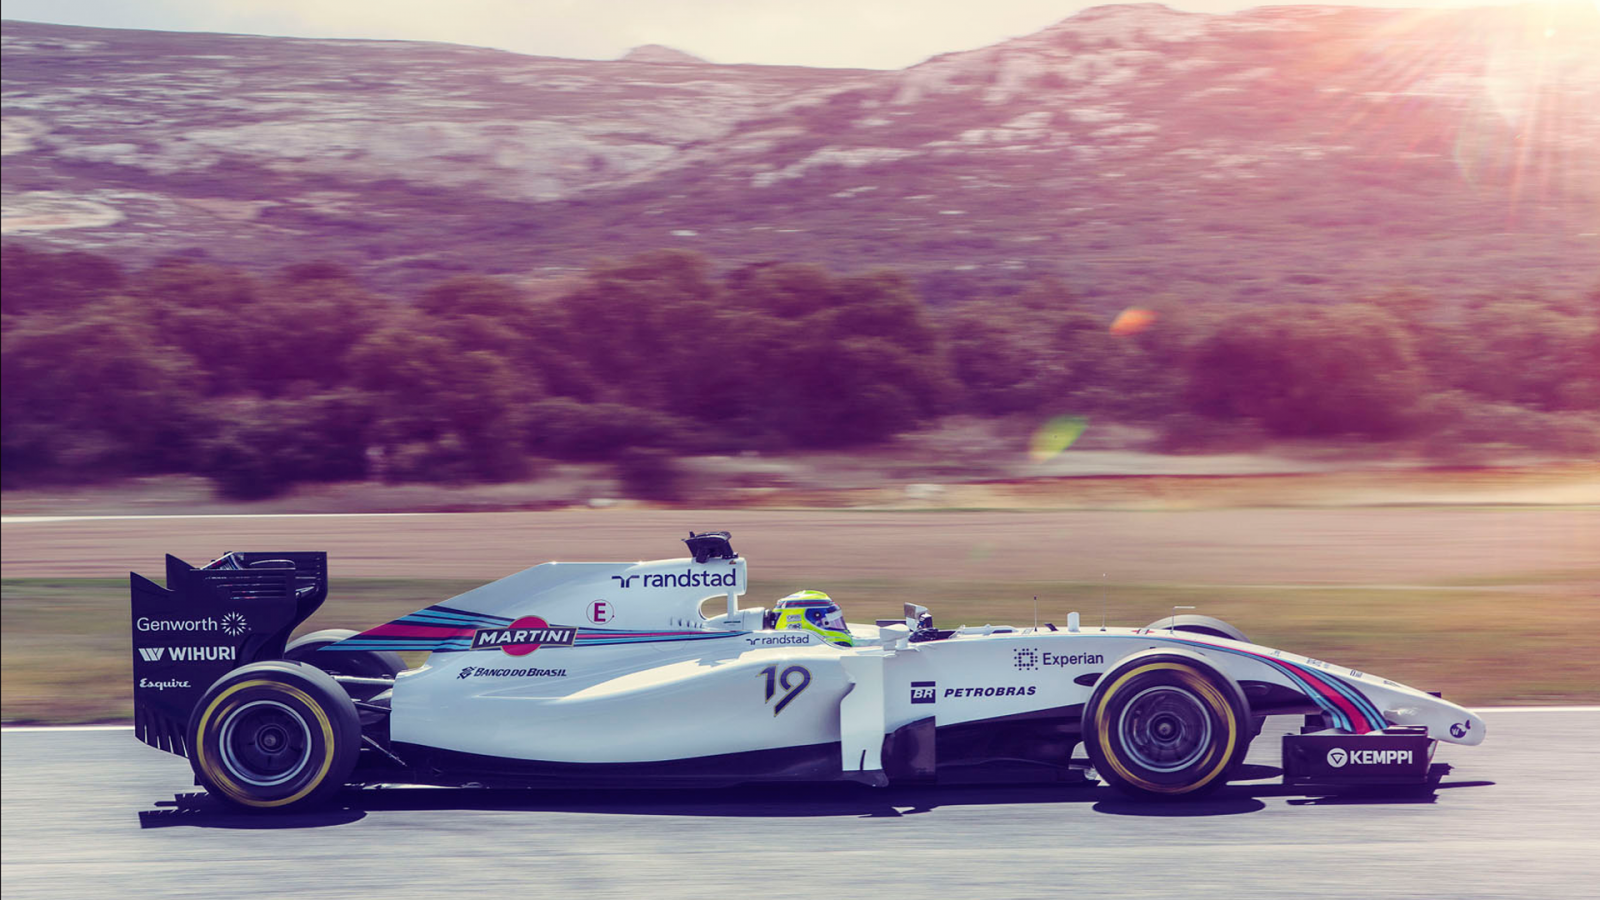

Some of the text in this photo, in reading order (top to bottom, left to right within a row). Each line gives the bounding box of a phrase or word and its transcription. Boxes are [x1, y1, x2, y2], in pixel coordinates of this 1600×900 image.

[643, 568, 736, 587] randstad
[593, 602, 606, 622] E
[136, 617, 218, 632] Genworth
[478, 629, 571, 645] MARTINI
[762, 634, 809, 645] randstad
[168, 646, 236, 661] WIHURI
[1042, 652, 1104, 668] Experian
[474, 667, 567, 677] BANCO DO BRASIL
[139, 677, 191, 691] Esquire
[756, 663, 813, 718] 19
[912, 685, 1037, 699] BR PETROBRAS
[1350, 750, 1413, 765] KEMPPI
